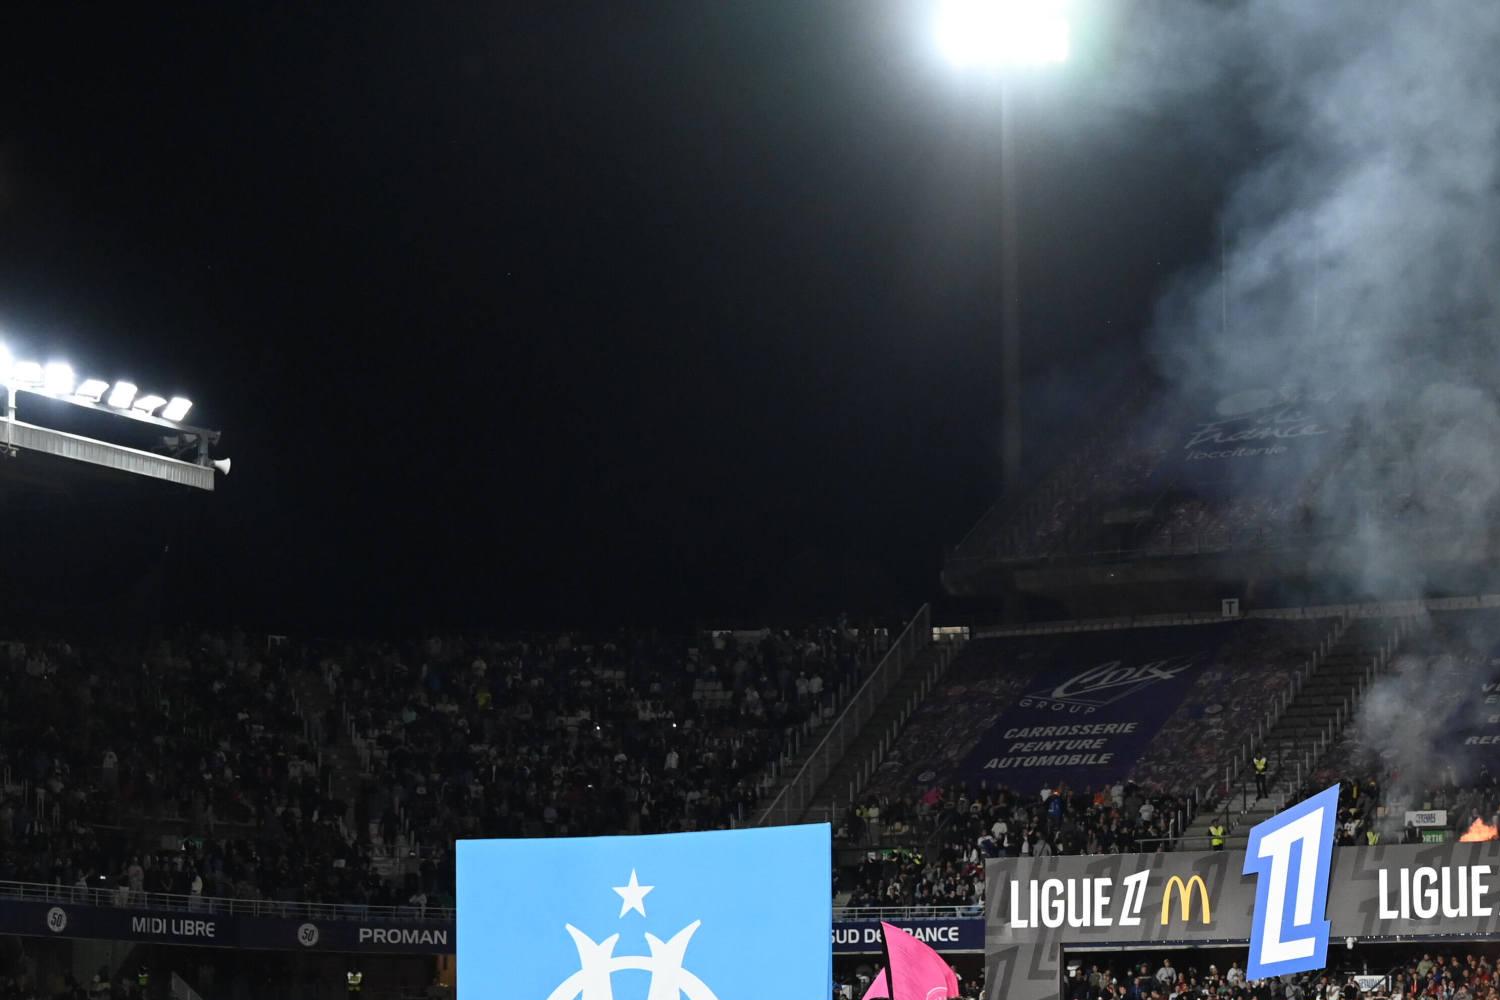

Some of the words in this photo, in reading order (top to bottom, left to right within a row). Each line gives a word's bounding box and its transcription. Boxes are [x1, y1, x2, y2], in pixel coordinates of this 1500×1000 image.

[1225, 601, 1236, 615] T
[1018, 699, 1095, 715] GROUP
[1003, 722, 1139, 740] CARROSSERIE
[1008, 738, 1108, 753] PEINTURE
[983, 753, 1114, 770] AUTOMOBILE
[1378, 864, 1492, 919] LIGUE
[1010, 877, 1112, 928] LIGUE
[132, 916, 166, 934] MIDI
[171, 919, 215, 938] LIBRE
[359, 928, 447, 945] PROMAN
